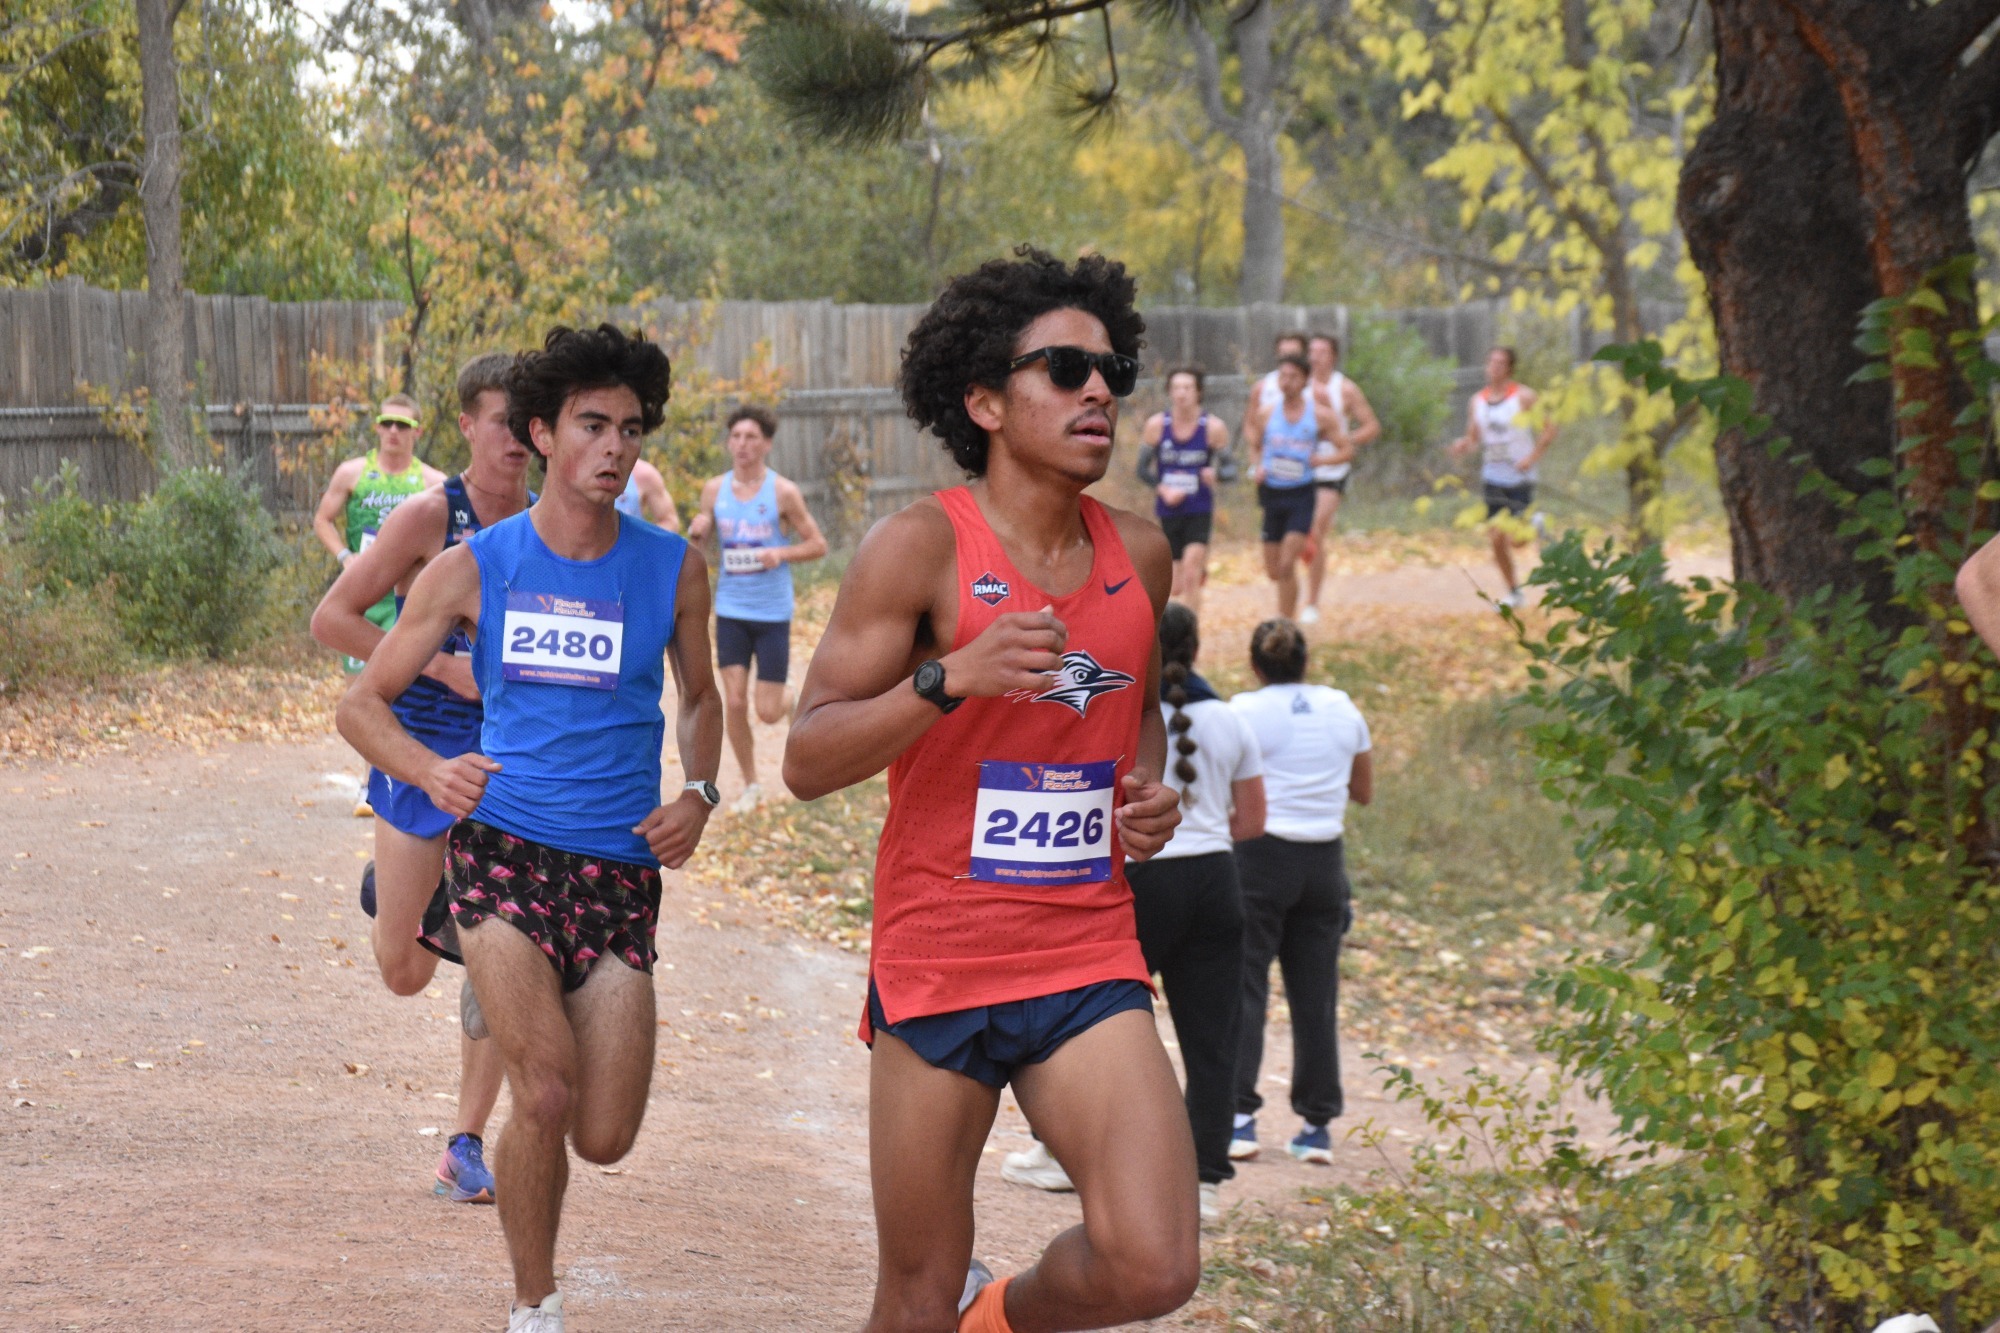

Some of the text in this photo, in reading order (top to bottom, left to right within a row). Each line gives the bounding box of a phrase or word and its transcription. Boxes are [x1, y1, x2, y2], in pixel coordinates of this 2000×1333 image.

[361, 490, 411, 509] Adam
[974, 583, 1008, 595] RMAC
[554, 598, 586, 609] Rapid
[510, 626, 613, 661] 2480
[1043, 770, 1083, 781] Rapid
[1042, 780, 1092, 790] Results
[984, 808, 1104, 848] 2426
